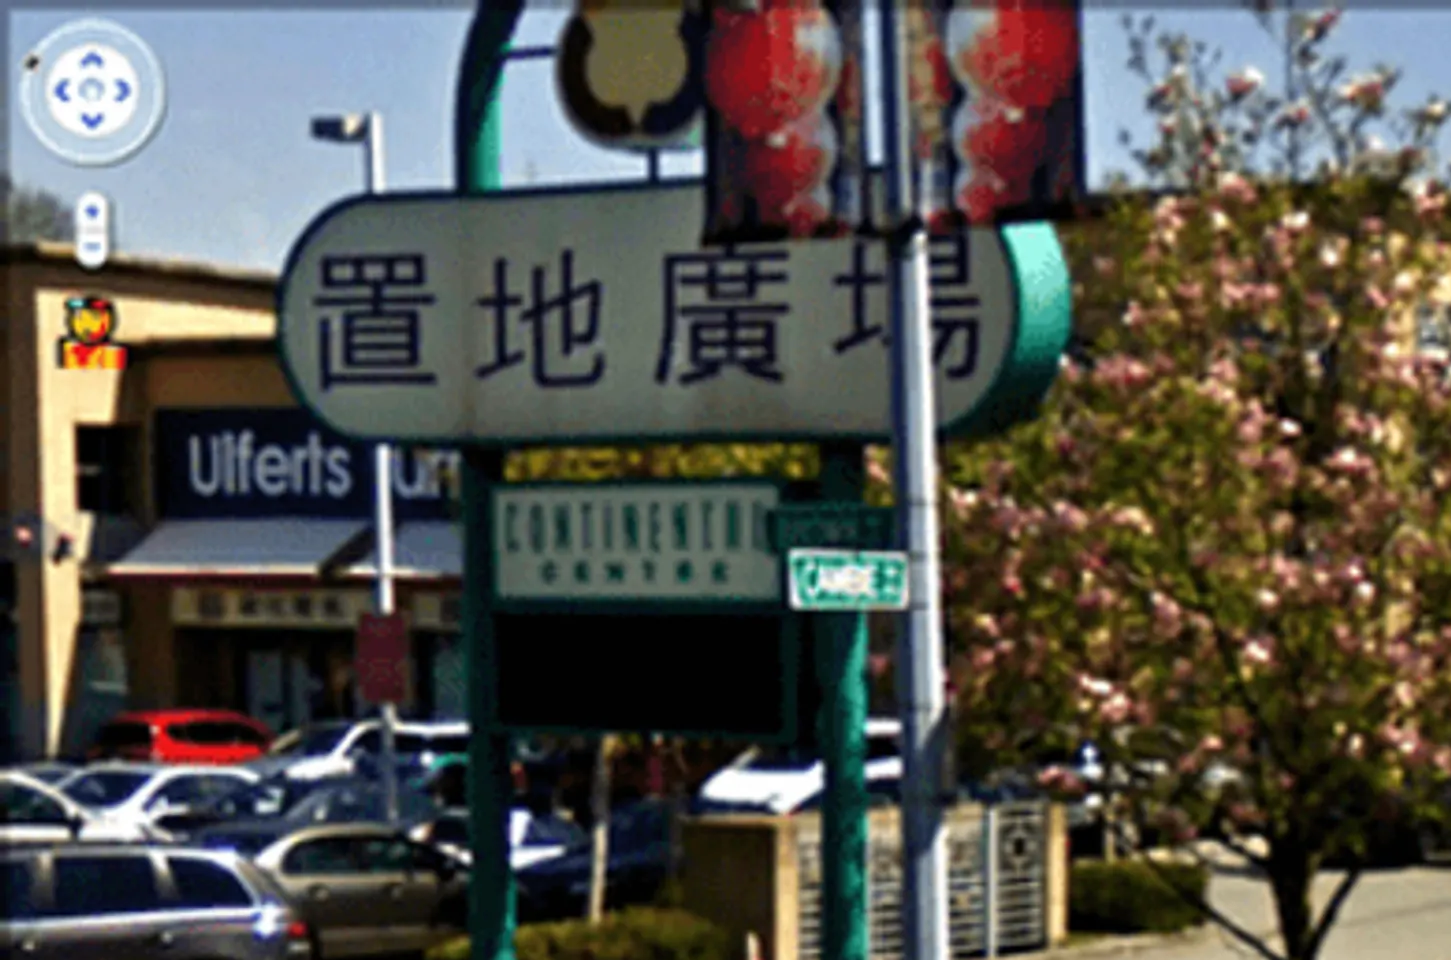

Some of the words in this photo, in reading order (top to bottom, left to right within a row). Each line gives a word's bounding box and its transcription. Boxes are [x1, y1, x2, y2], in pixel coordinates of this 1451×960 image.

[312, 240, 982, 393] 置地廣場
[188, 430, 352, 497] Ulferts
